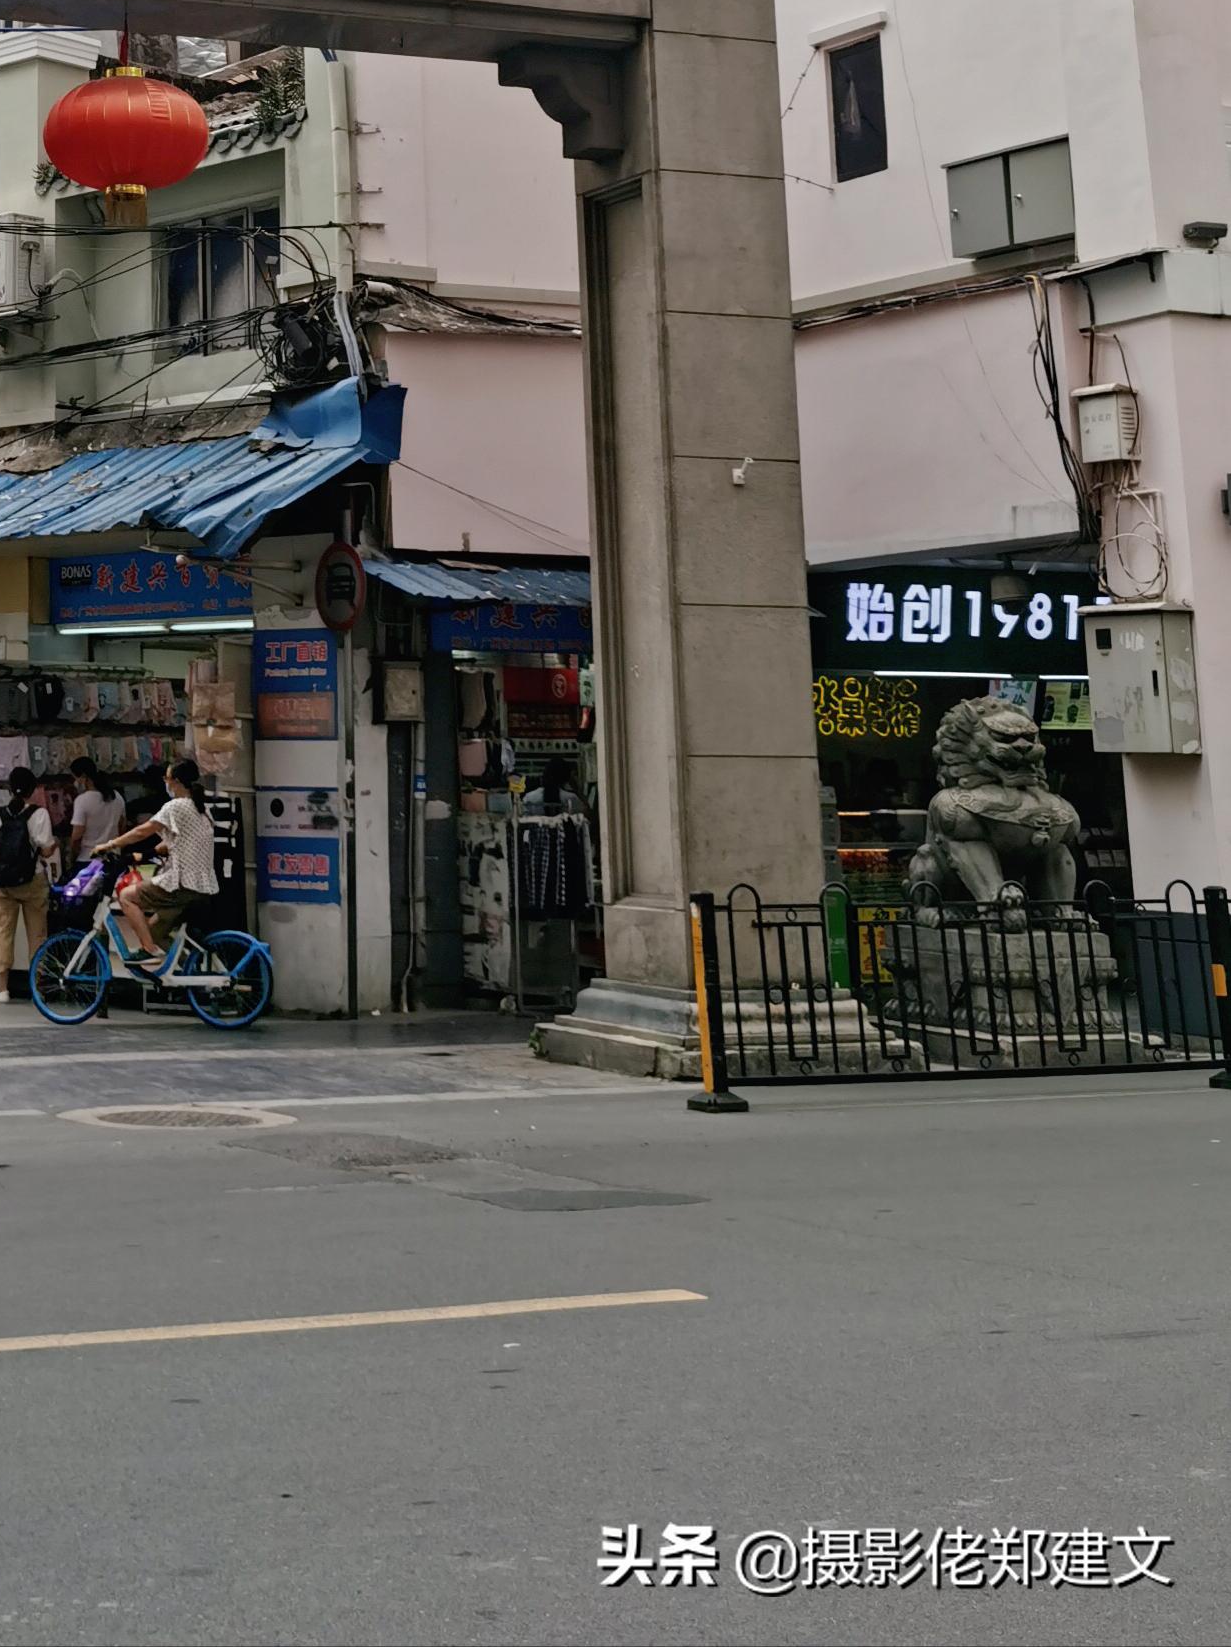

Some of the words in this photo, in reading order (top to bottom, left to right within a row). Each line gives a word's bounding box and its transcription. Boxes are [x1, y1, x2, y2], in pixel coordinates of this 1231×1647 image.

[61, 565, 92, 580] BONAS
[846, 582, 1113, 643] 始创1981
[265, 641, 328, 663] 工厂直销
